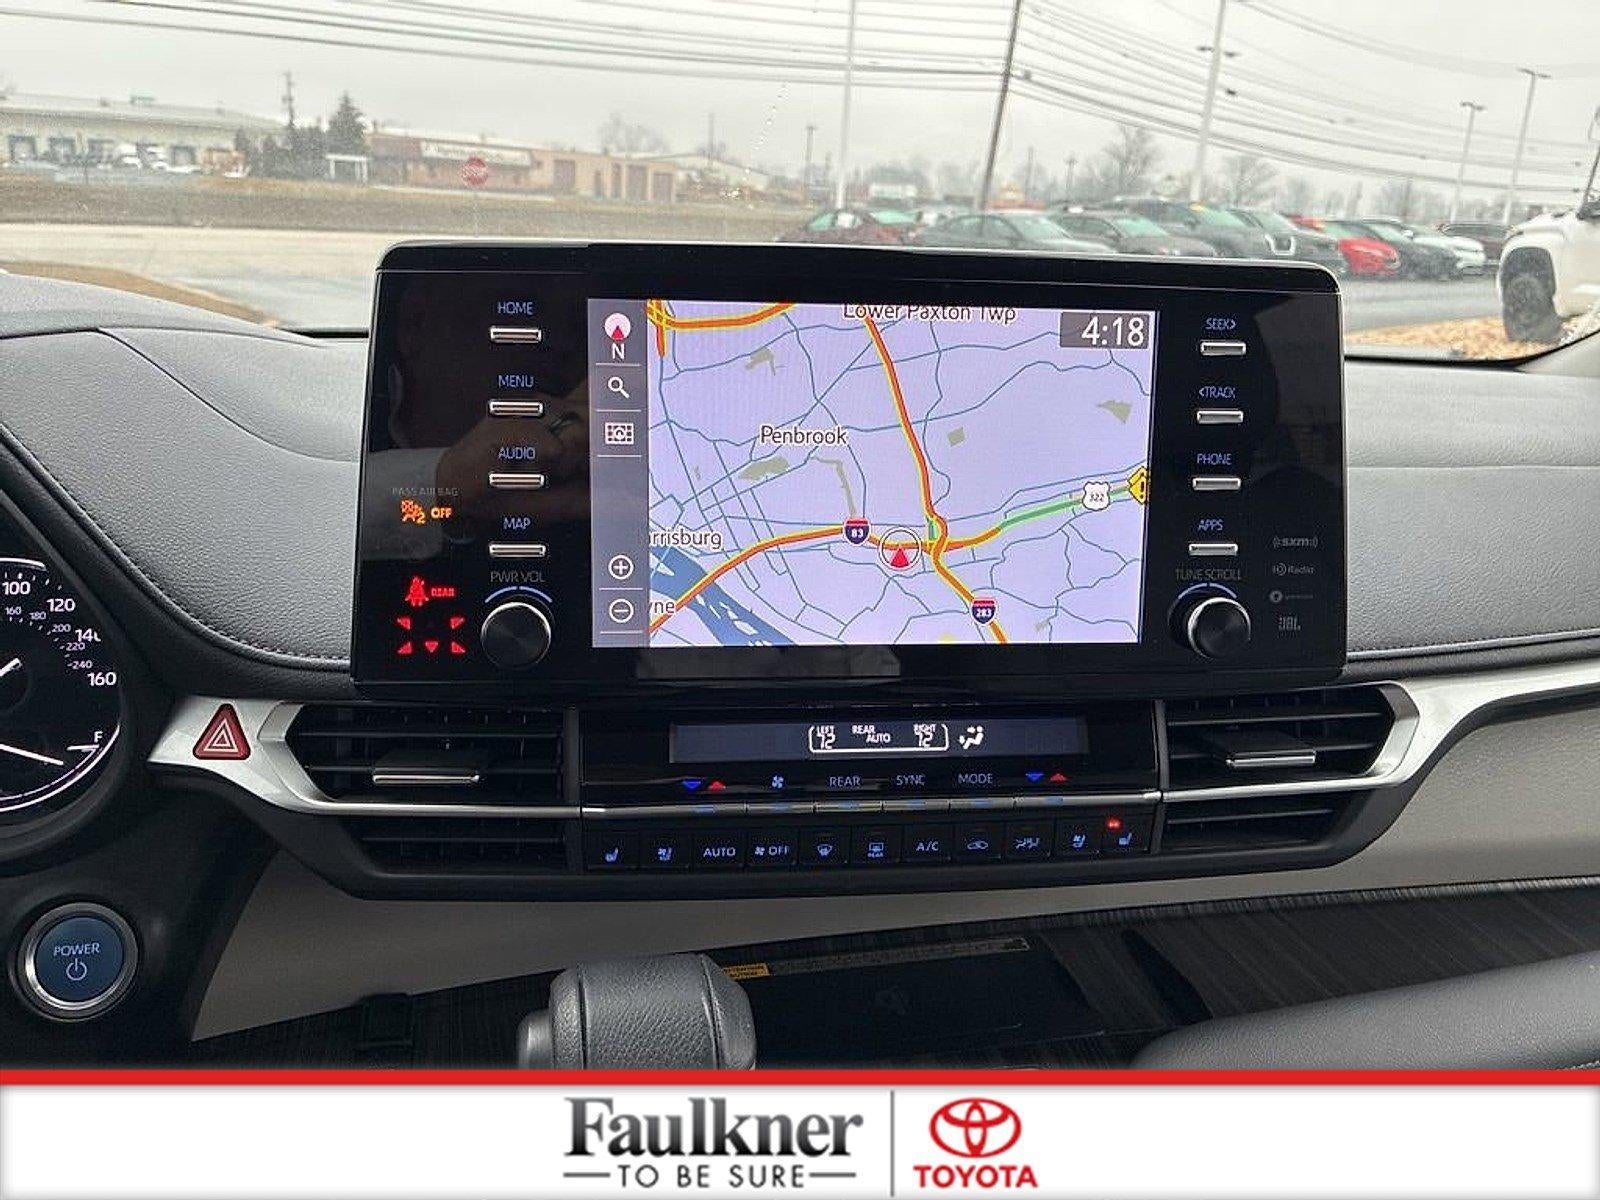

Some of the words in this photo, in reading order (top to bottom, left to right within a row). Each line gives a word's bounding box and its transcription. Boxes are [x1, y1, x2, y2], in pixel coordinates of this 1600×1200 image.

[497, 301, 534, 315] HOME
[843, 303, 901, 319] Lower
[907, 305, 972, 321] Paxton
[1081, 316, 1145, 347] 4:18
[611, 344, 625, 360] N
[498, 374, 534, 388] MENU
[760, 425, 848, 445] Penbrook
[498, 446, 536, 461] AUDIO
[1196, 453, 1232, 466] PHONE
[430, 507, 452, 519] OFF
[503, 517, 531, 531] MAP
[1198, 519, 1223, 531] APPS
[851, 528, 864, 539] 83
[490, 570, 519, 583] PWR
[2, 581, 31, 595] 100
[5, 606, 22, 616] 160
[46, 598, 76, 612] 120
[29, 611, 47, 620] 180
[51, 624, 72, 633] 200
[66, 642, 86, 651] 220
[72, 660, 94, 670] 240
[87, 672, 117, 687] 160
[852, 725, 876, 734] REAR
[94, 731, 103, 743] F
[865, 733, 891, 743] AUTO
[829, 776, 861, 787] REAR
[896, 775, 926, 786] SYNC
[957, 773, 993, 784] MODE
[703, 847, 736, 858] AUTO
[768, 845, 790, 856] OFF
[916, 841, 939, 852] A/C
[53, 942, 100, 957] POWER
